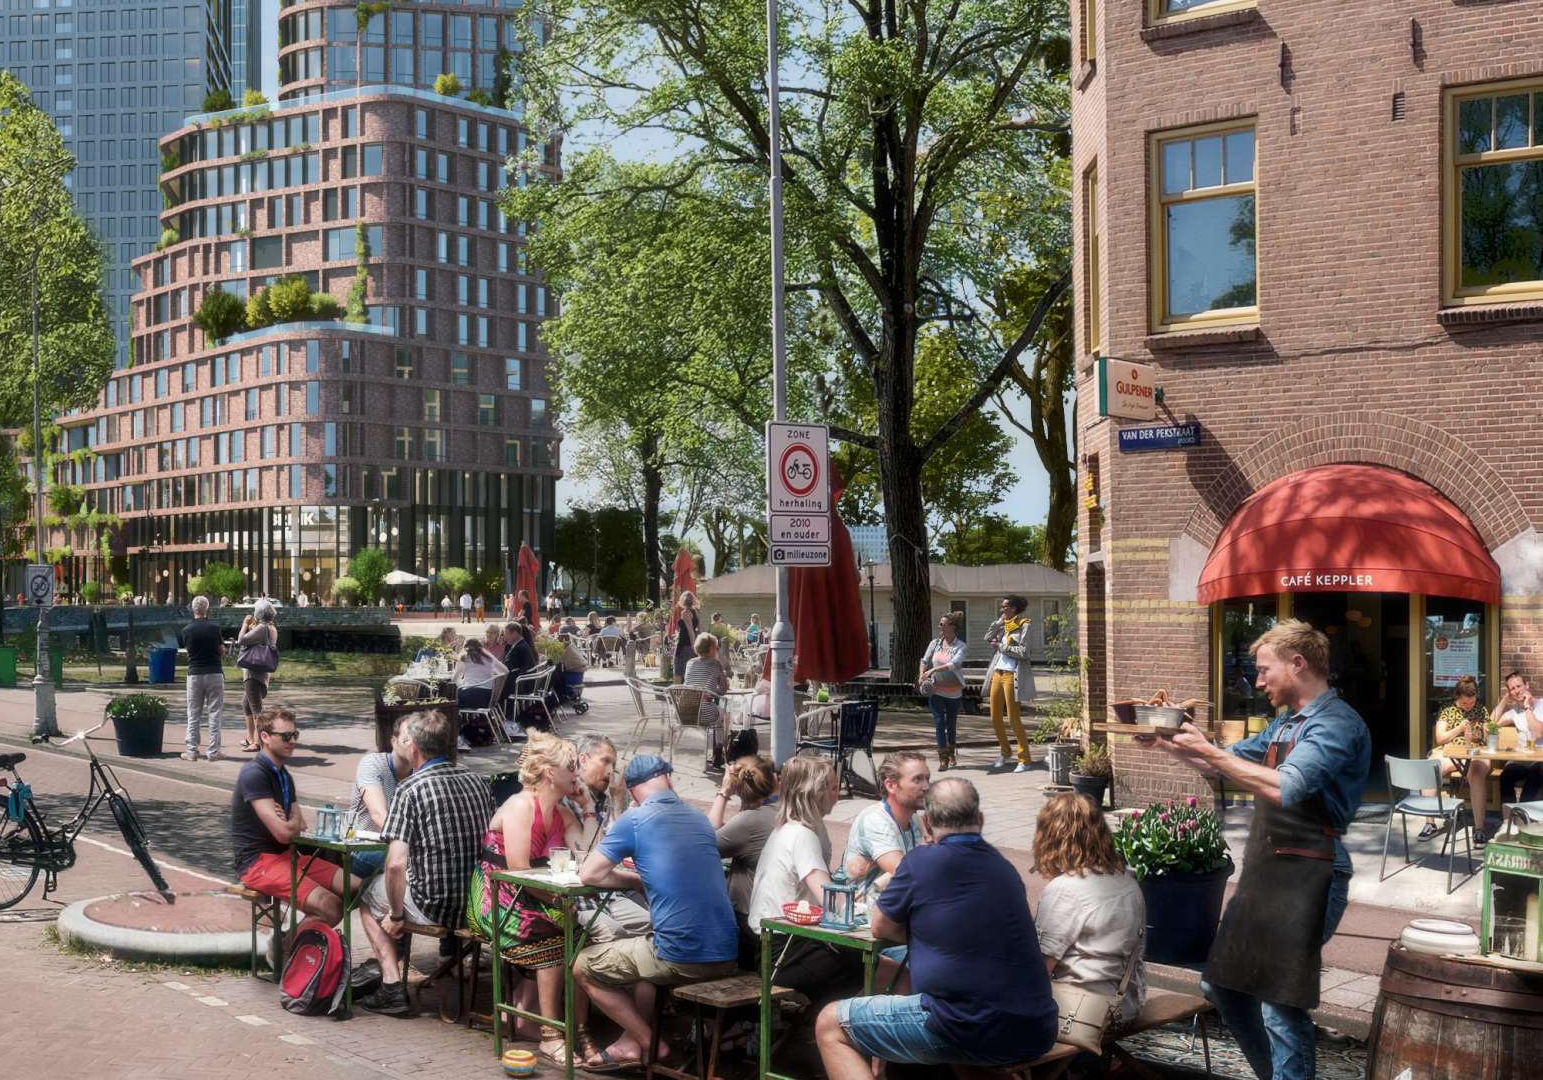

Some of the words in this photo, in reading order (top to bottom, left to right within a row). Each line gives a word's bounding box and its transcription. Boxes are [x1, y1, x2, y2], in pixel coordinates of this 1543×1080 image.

[1116, 380, 1153, 399] GULPENER
[787, 430, 810, 439] ZONE
[1122, 430, 1138, 440] VAN
[1139, 429, 1154, 440] DER
[1156, 426, 1195, 438] PEKSTRAAT
[779, 498, 822, 510] herhaling
[790, 518, 811, 528] 2010
[794, 530, 820, 539] ouder
[787, 550, 827, 559] milieuzone
[1281, 570, 1312, 586] CAFÉ
[1316, 575, 1373, 586] KEPPLER
